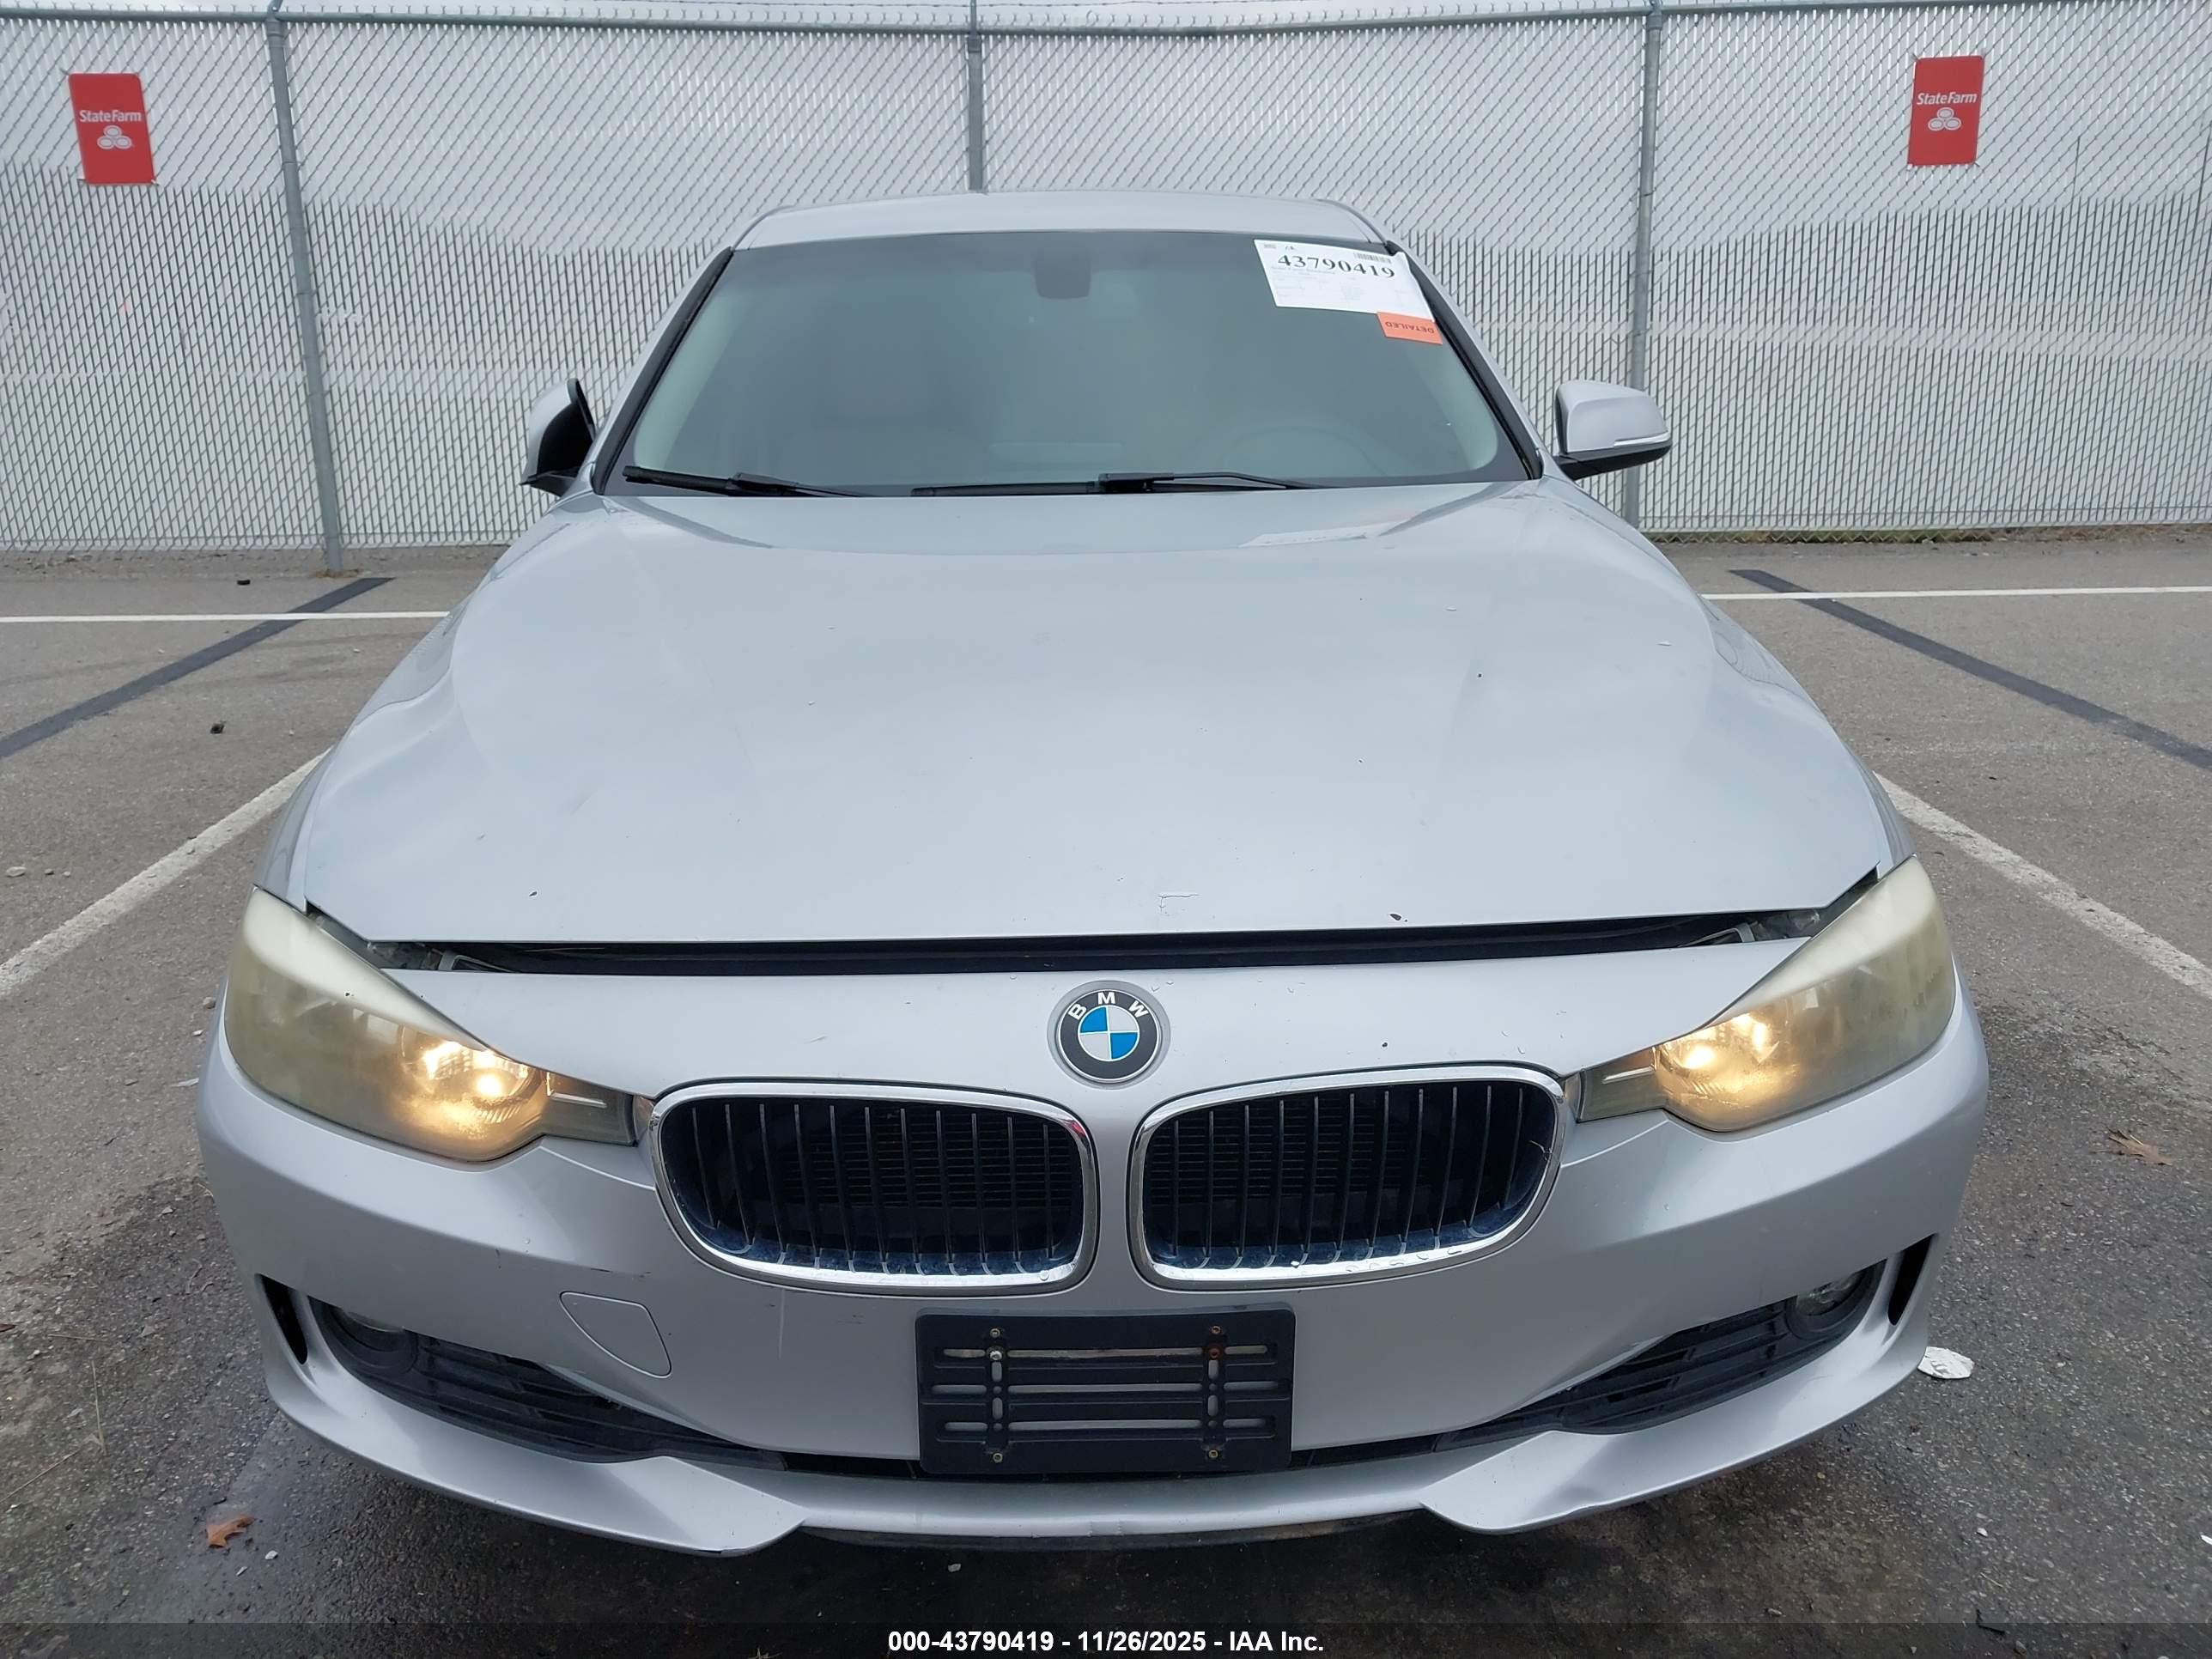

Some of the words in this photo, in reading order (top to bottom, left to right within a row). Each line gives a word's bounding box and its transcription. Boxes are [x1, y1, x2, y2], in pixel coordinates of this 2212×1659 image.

[1278, 254, 1395, 278] 43790419
[1385, 321, 1435, 334] DETAILED
[1067, 991, 1149, 1020] BMW
